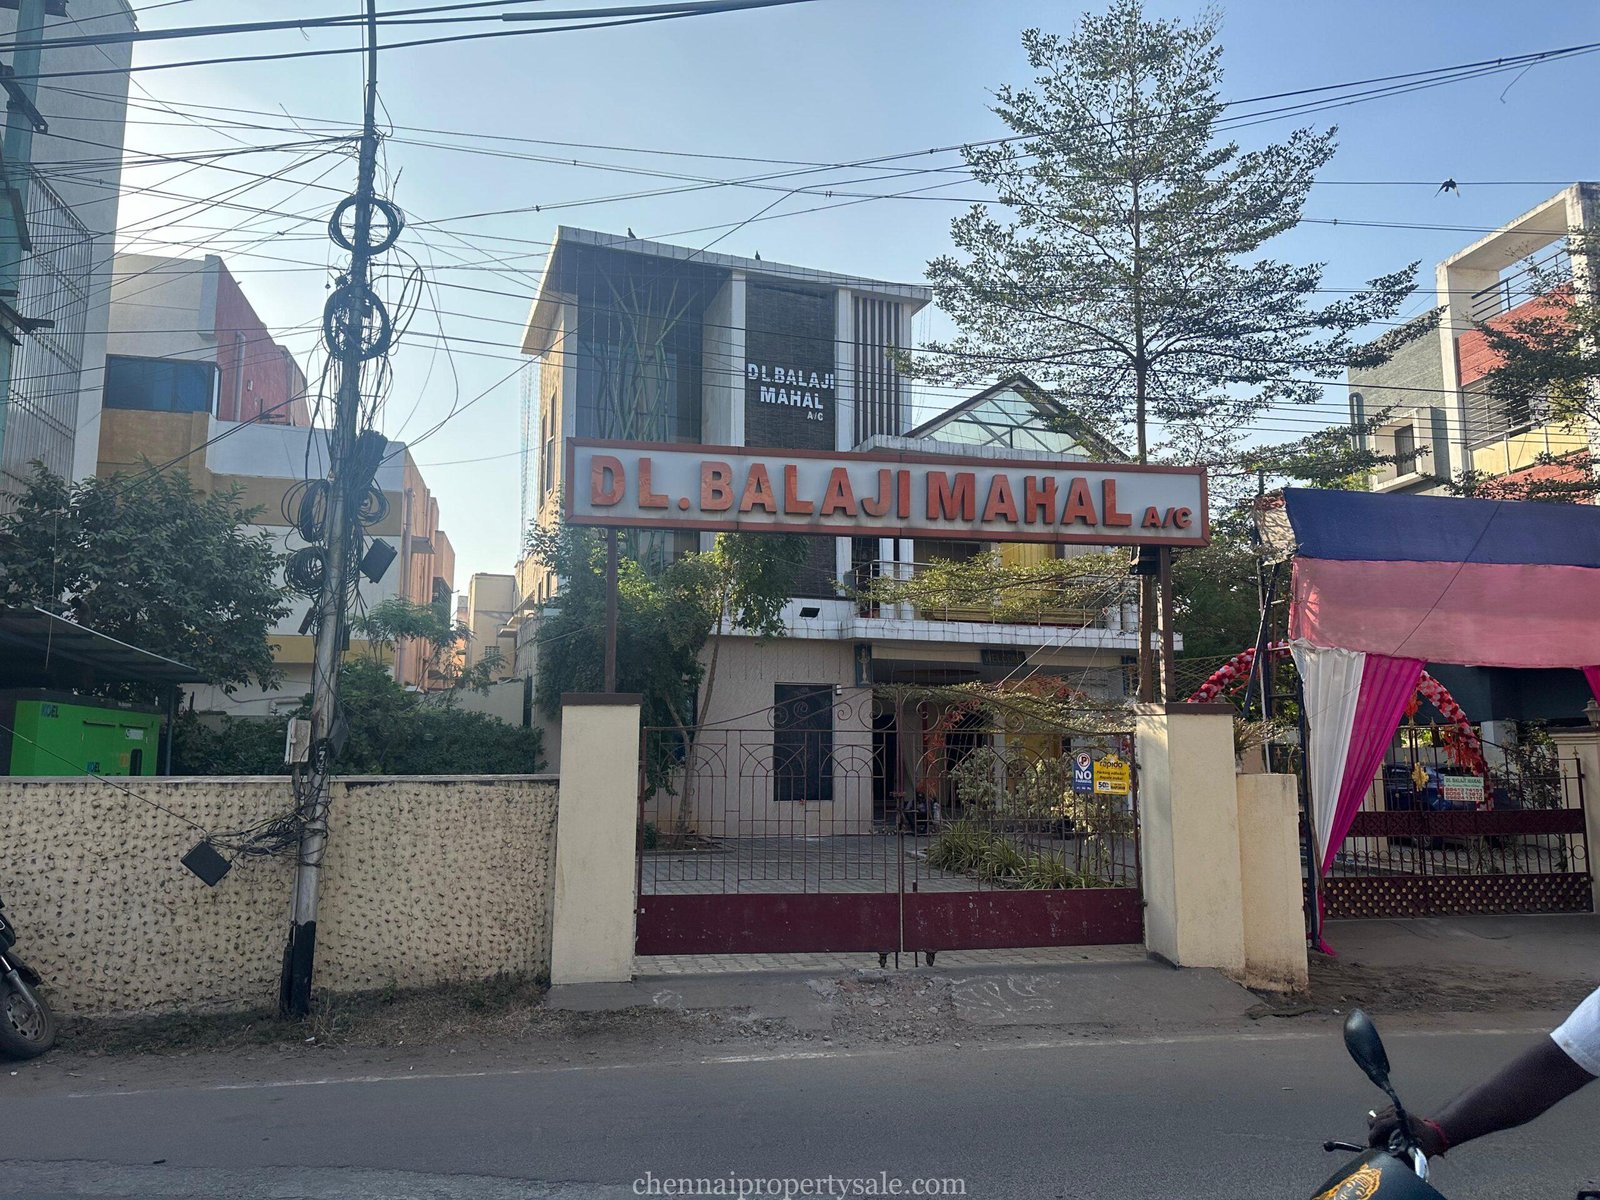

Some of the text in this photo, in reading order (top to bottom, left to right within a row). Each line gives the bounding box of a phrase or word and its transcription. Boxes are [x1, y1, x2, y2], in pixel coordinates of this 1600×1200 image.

[760, 386, 824, 409] MAHAL
[807, 411, 824, 421] A/C
[926, 471, 1133, 528] MAHAL
[1142, 506, 1193, 530] A/C
[1075, 770, 1092, 780] NO
